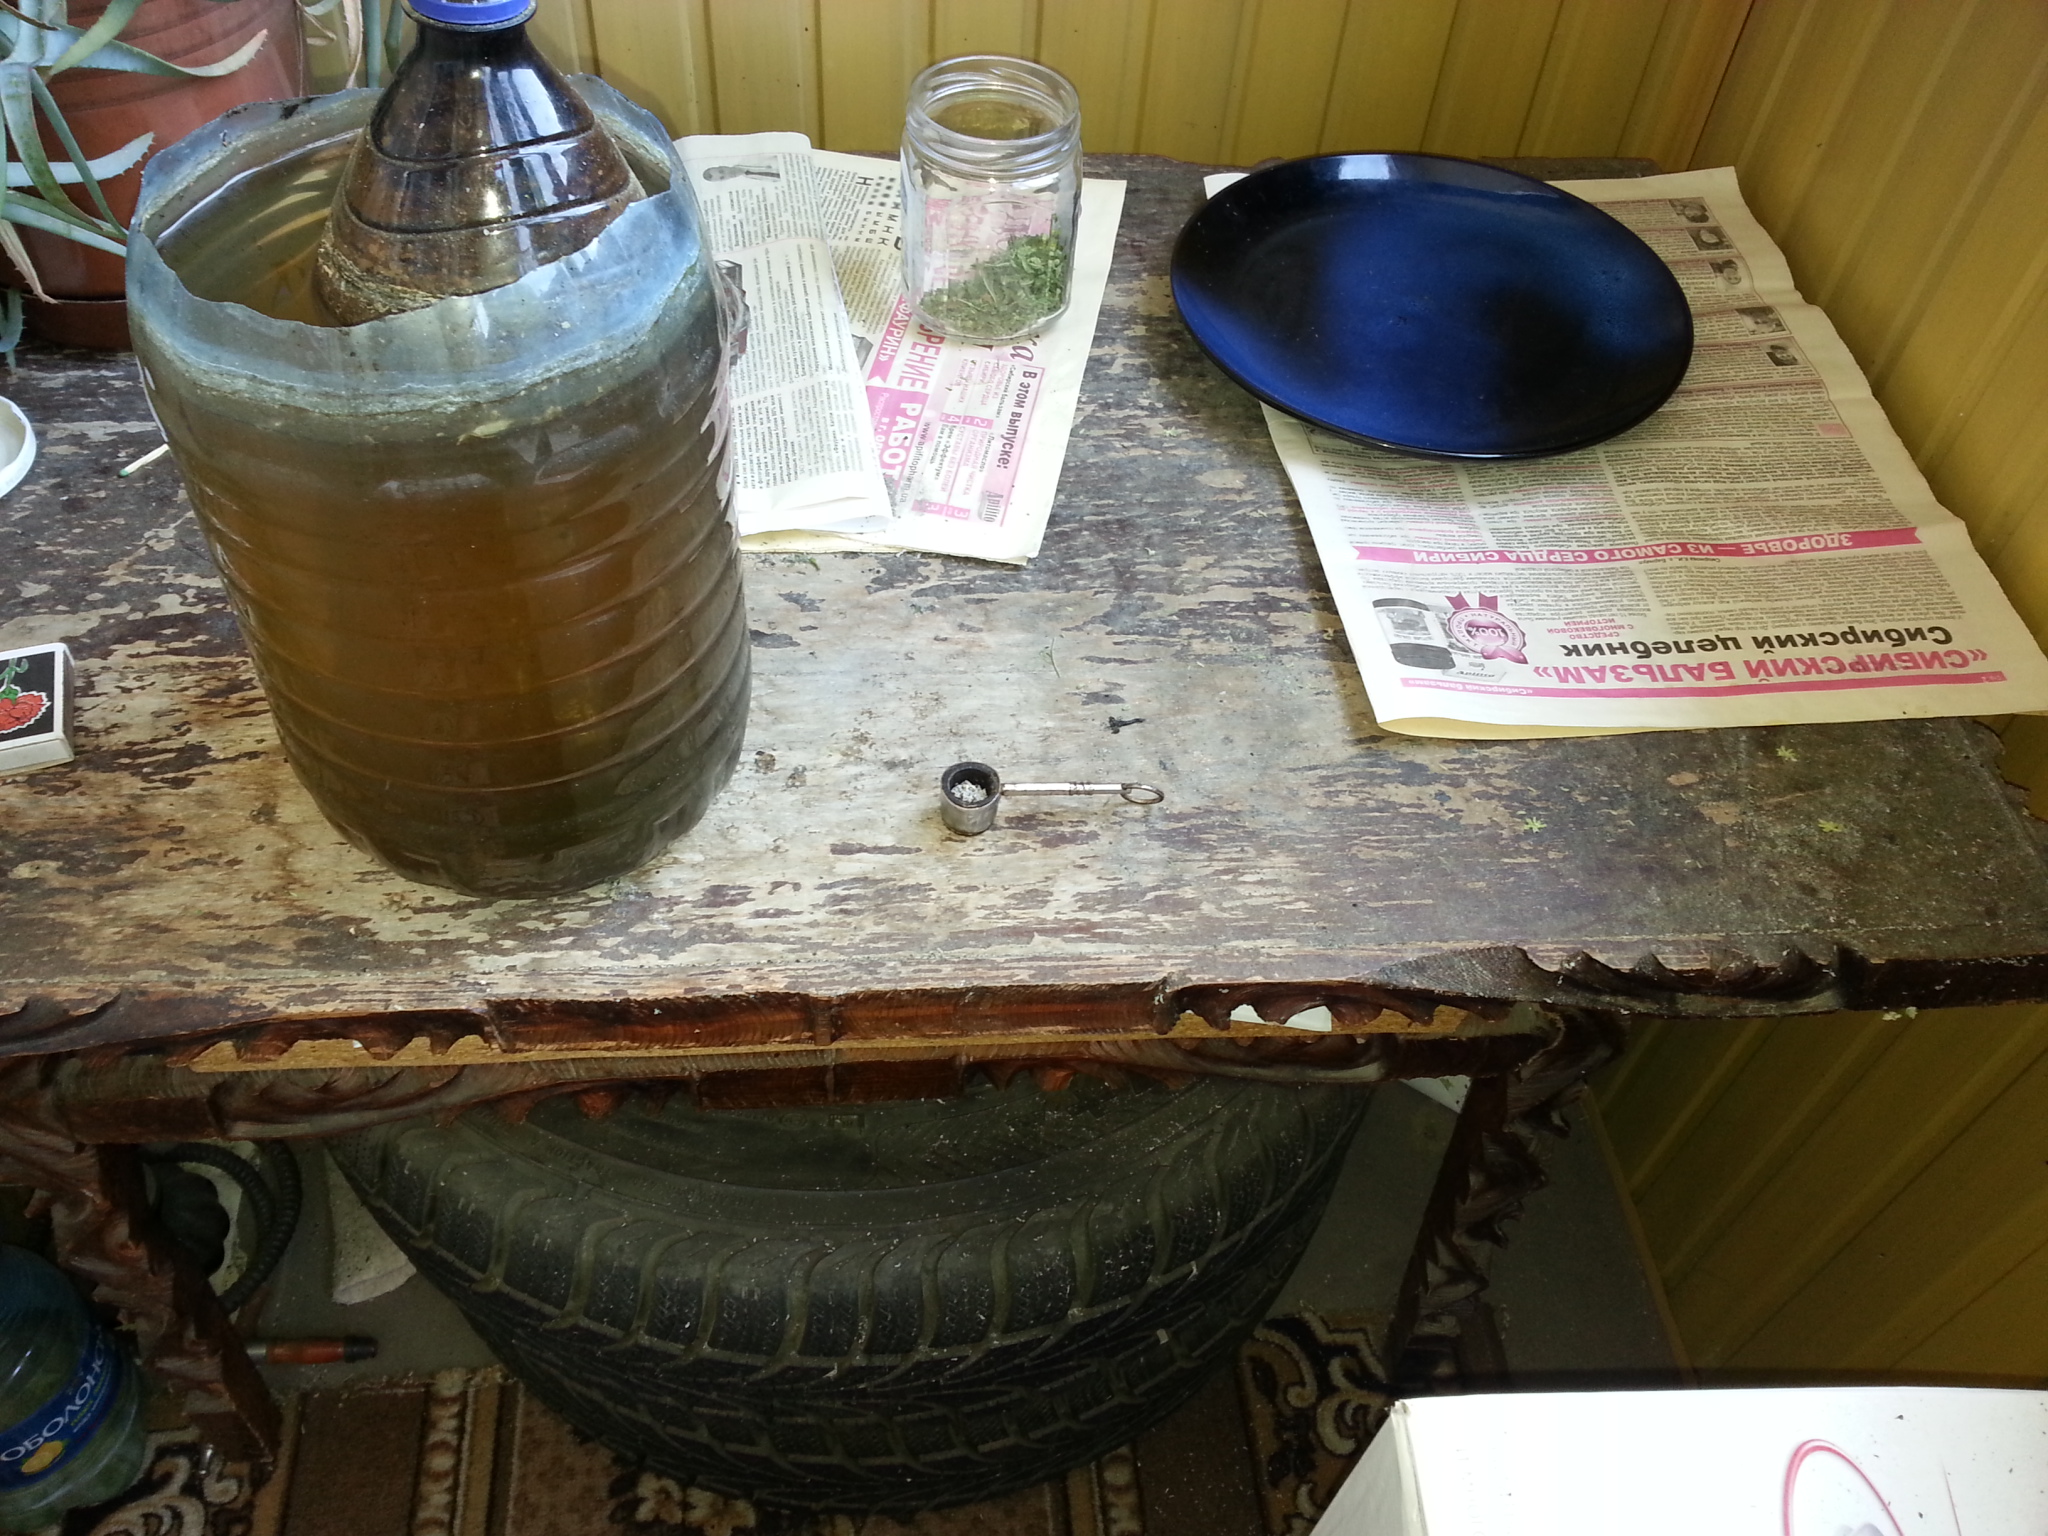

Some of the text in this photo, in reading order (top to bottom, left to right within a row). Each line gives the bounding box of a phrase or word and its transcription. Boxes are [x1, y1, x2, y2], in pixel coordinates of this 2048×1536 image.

[879, 302, 910, 362] ФАУРИН»
[1022, 371, 1038, 379] В
[1013, 382, 1031, 408] этом
[997, 411, 1023, 469] выпуске:
[900, 421, 931, 503] www.apifitopharm.ua
[1688, 544, 1715, 554] ИЗ
[1740, 533, 1853, 555] ЗДОРОВЬЕ
[1412, 551, 1499, 563] СИБИРИ
[1503, 549, 1588, 562] СЕРДЦА
[1594, 544, 1682, 561] САМОГО
[1547, 624, 1626, 634] МНОГОВЕКОВОЙ
[1564, 618, 1616, 627] ИСТОРИЕЙ
[1467, 626, 1506, 637] 100%
[1569, 631, 1620, 640] СРЕДСТВО
[1559, 625, 1953, 660] Сибирский целебник
[1533, 648, 1989, 684] «СИБИРСКИЙ БАЛЬЗАМ»
